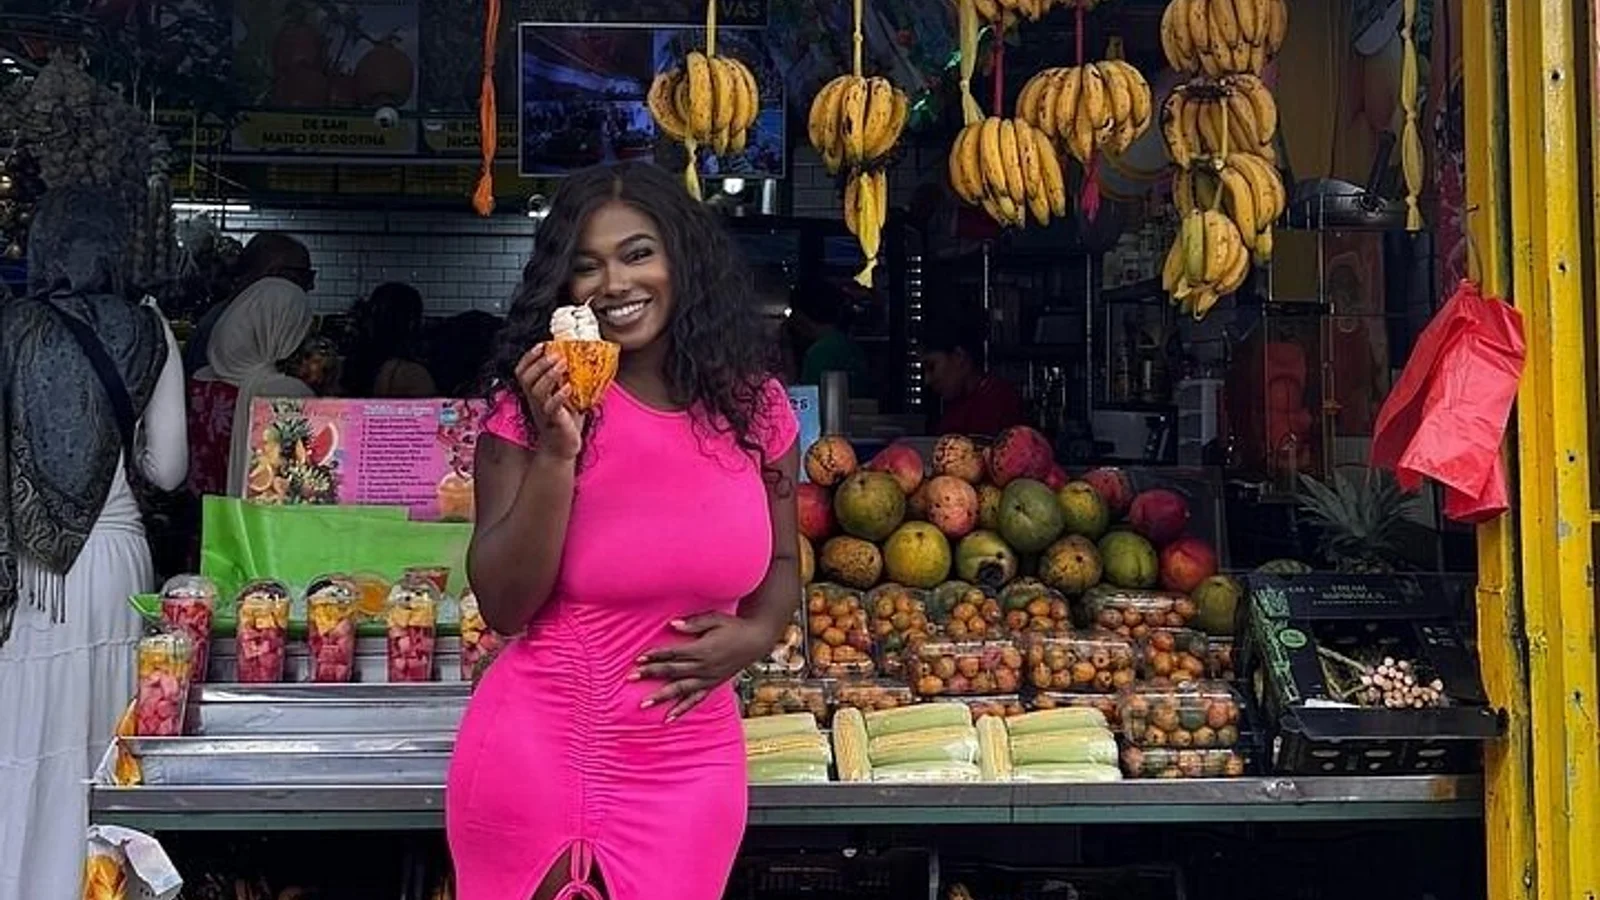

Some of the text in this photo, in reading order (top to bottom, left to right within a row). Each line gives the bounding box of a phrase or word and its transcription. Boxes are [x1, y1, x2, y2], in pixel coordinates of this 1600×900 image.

[302, 118, 348, 131] DE SAN
[263, 132, 306, 145] MATEO
[309, 133, 328, 145] DE
